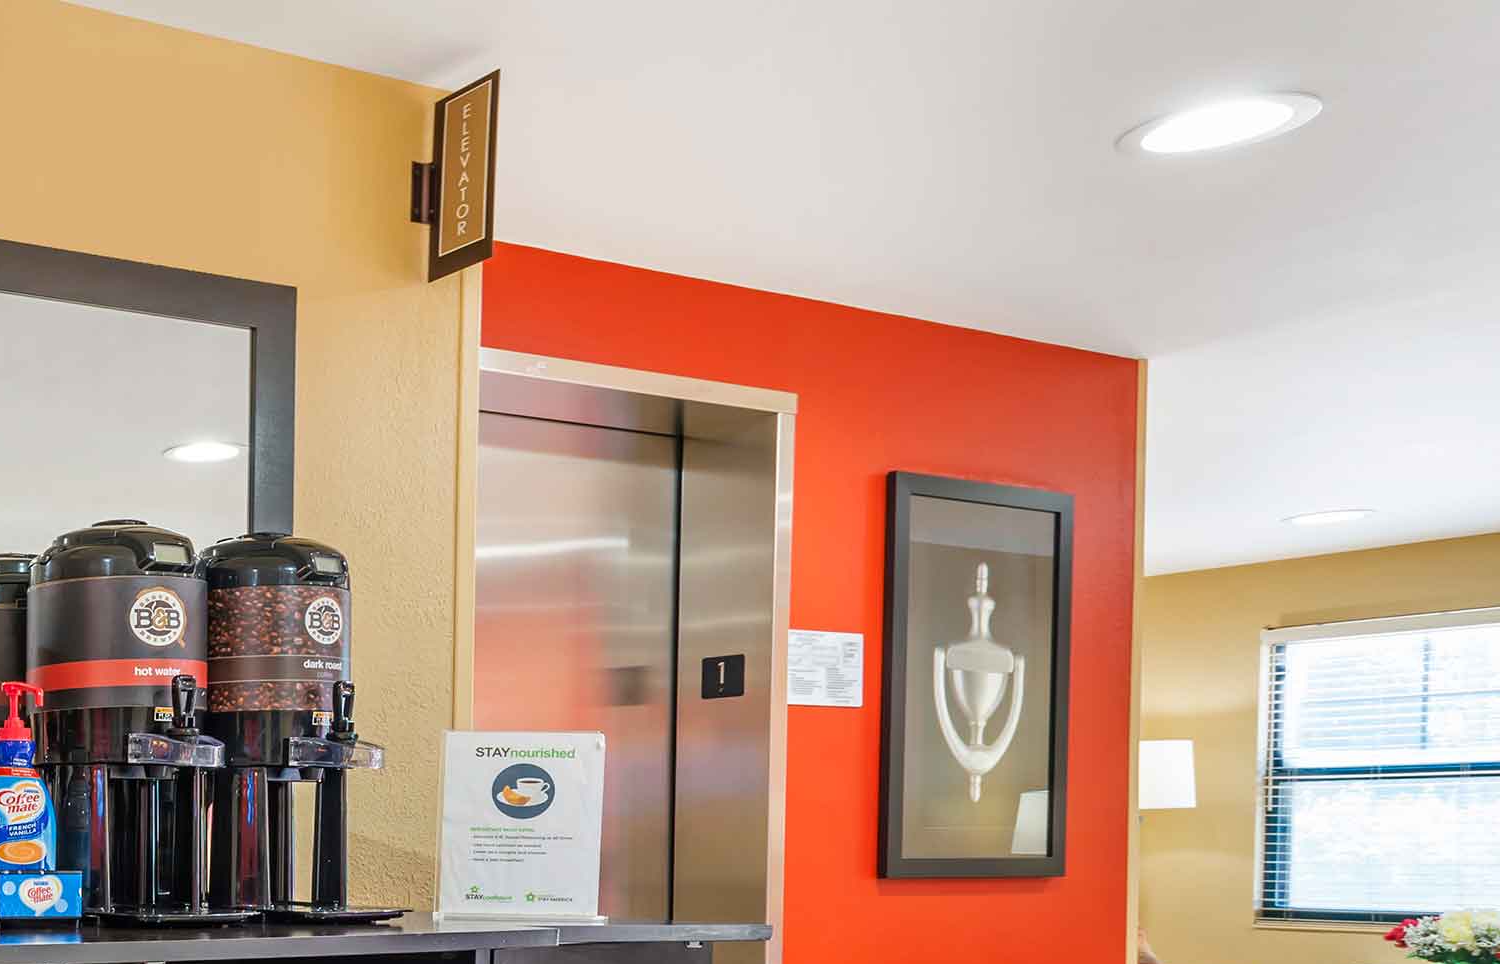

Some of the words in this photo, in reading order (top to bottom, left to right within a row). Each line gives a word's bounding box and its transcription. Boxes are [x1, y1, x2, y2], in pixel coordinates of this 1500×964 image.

[456, 103, 472, 236] ELEVATOR
[134, 607, 181, 629] B&B
[308, 612, 340, 630] B&B
[303, 659, 324, 669] dark
[325, 662, 342, 670] roast
[134, 666, 153, 676] hot
[154, 667, 181, 676] water
[717, 661, 725, 685] 1
[7, 803, 38, 814] mate
[8, 823, 36, 832] FRENCH
[9, 829, 37, 837] VANILLA
[28, 887, 52, 898] Coffee
